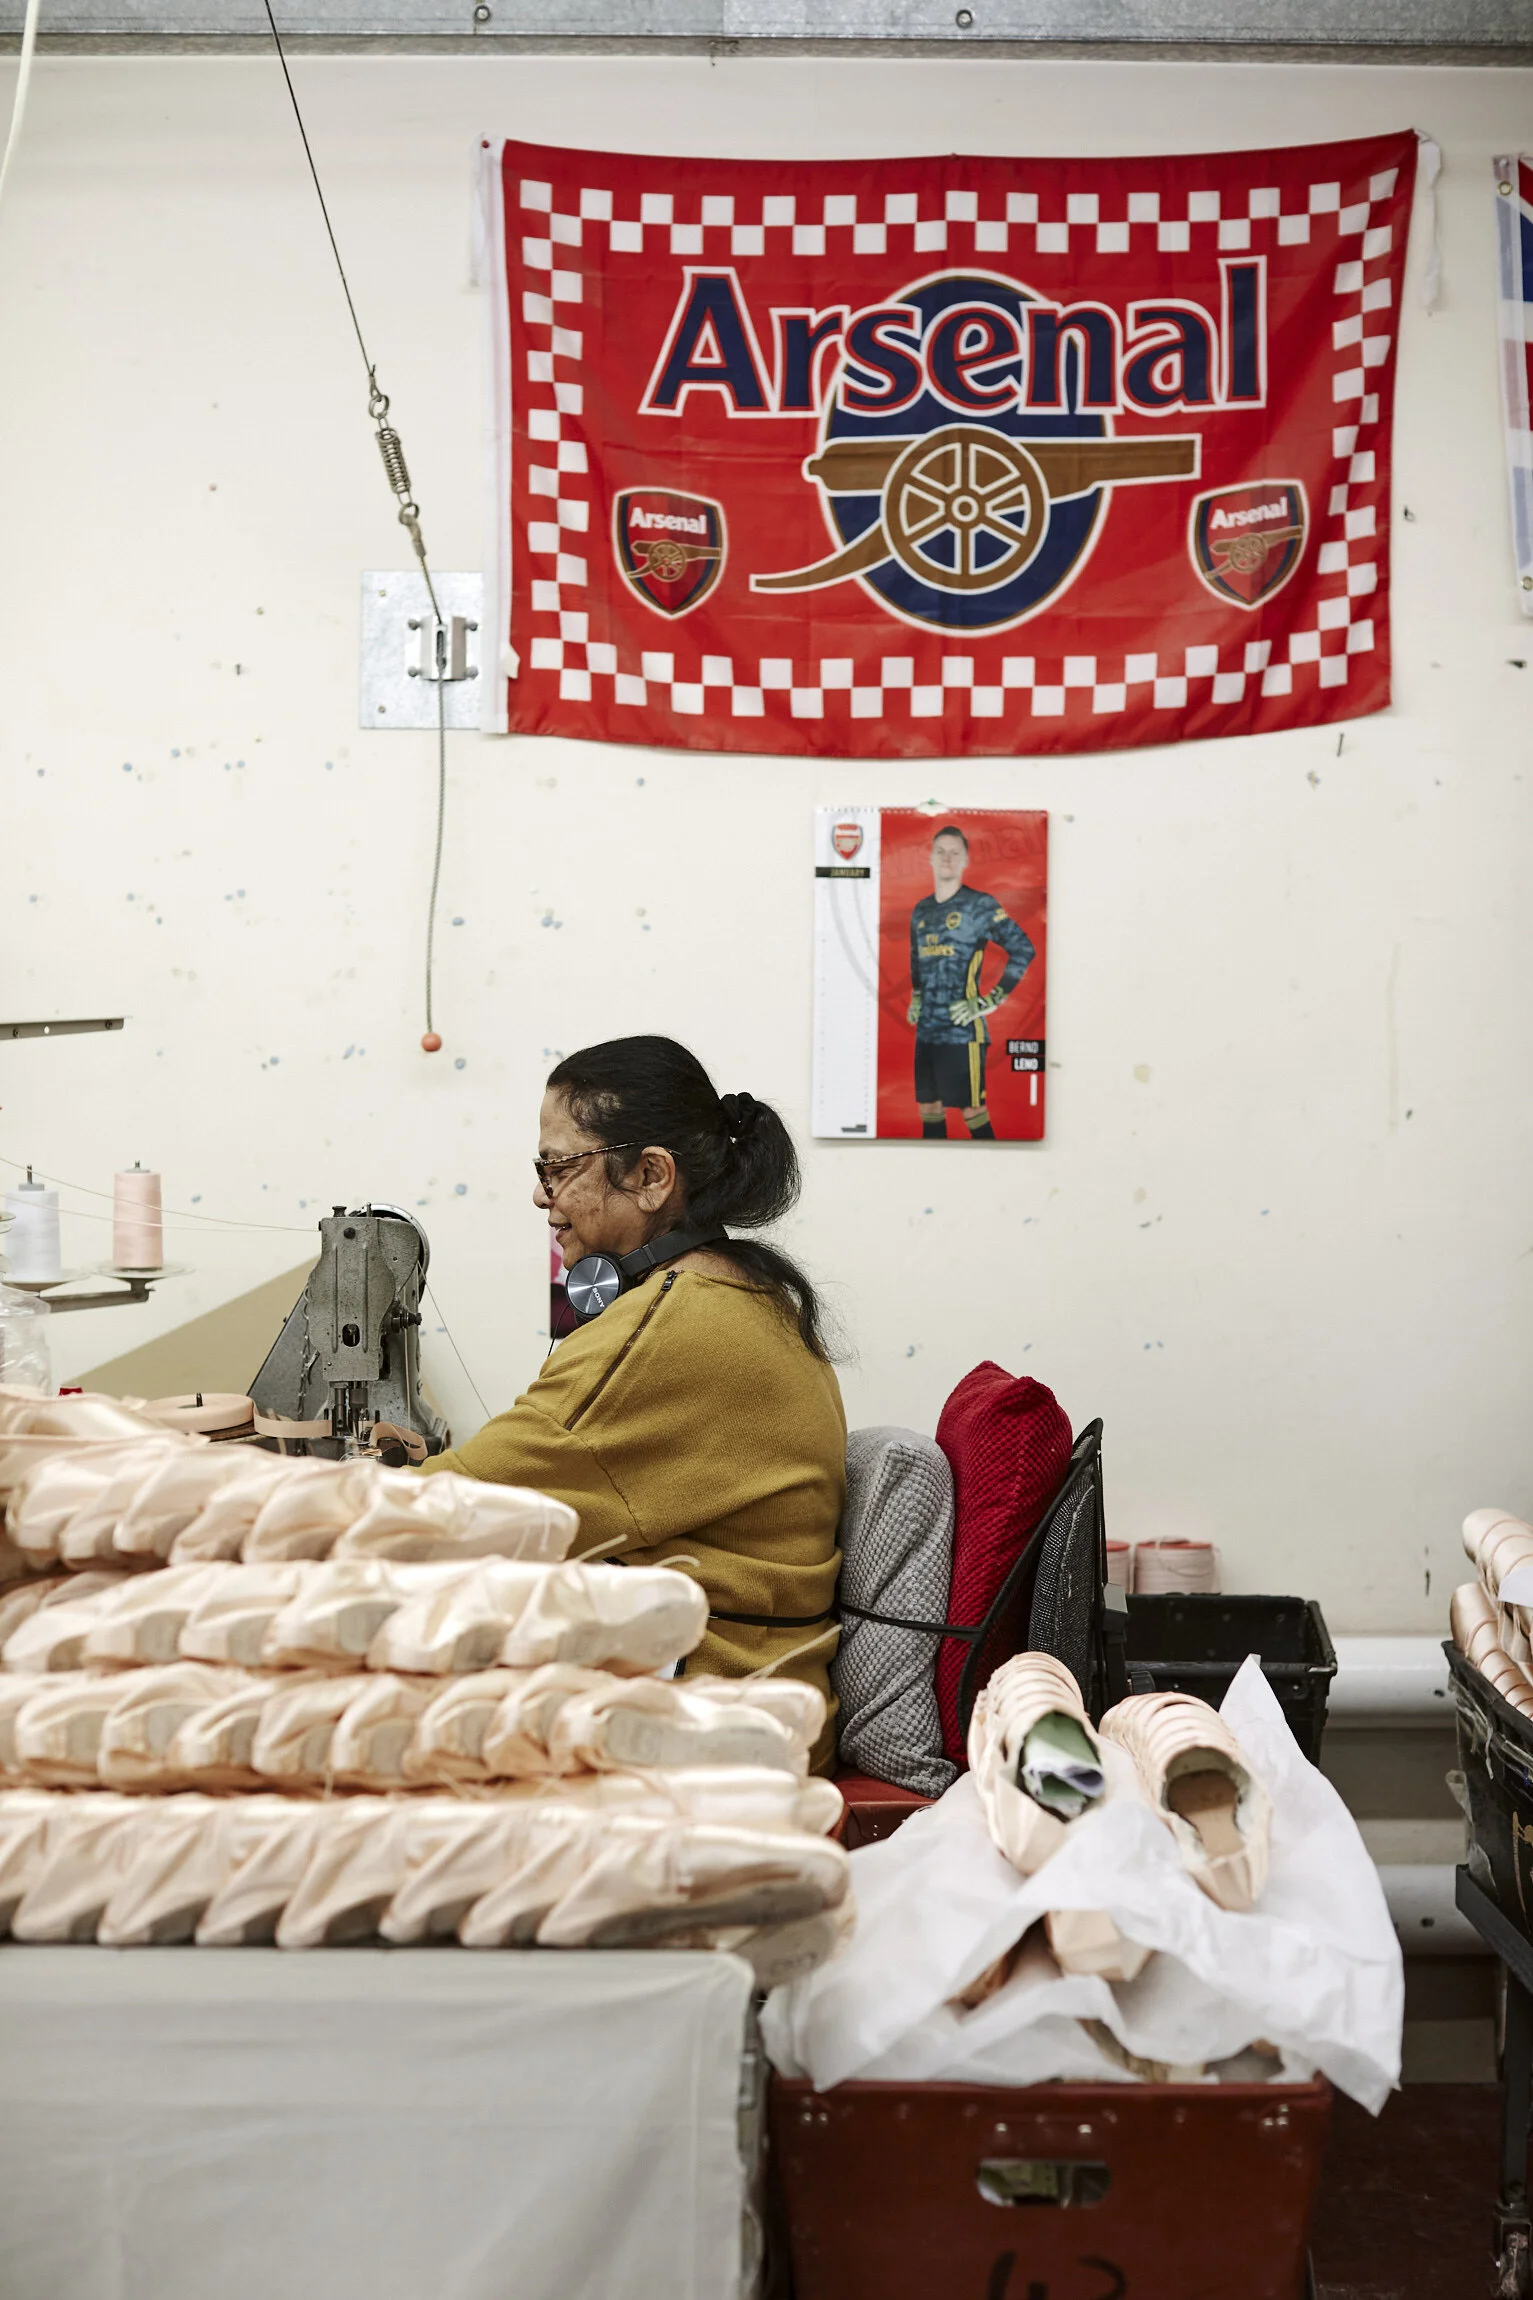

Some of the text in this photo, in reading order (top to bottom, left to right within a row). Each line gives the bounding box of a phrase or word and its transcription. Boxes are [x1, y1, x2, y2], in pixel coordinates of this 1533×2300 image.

[638, 255, 1267, 418] Arsenal
[629, 507, 707, 534] Arsenal
[1210, 496, 1288, 530] Arsenal
[1008, 1040, 1039, 1054] BERND
[1014, 1057, 1039, 1071] LENO
[592, 1287, 605, 1308] SONY
